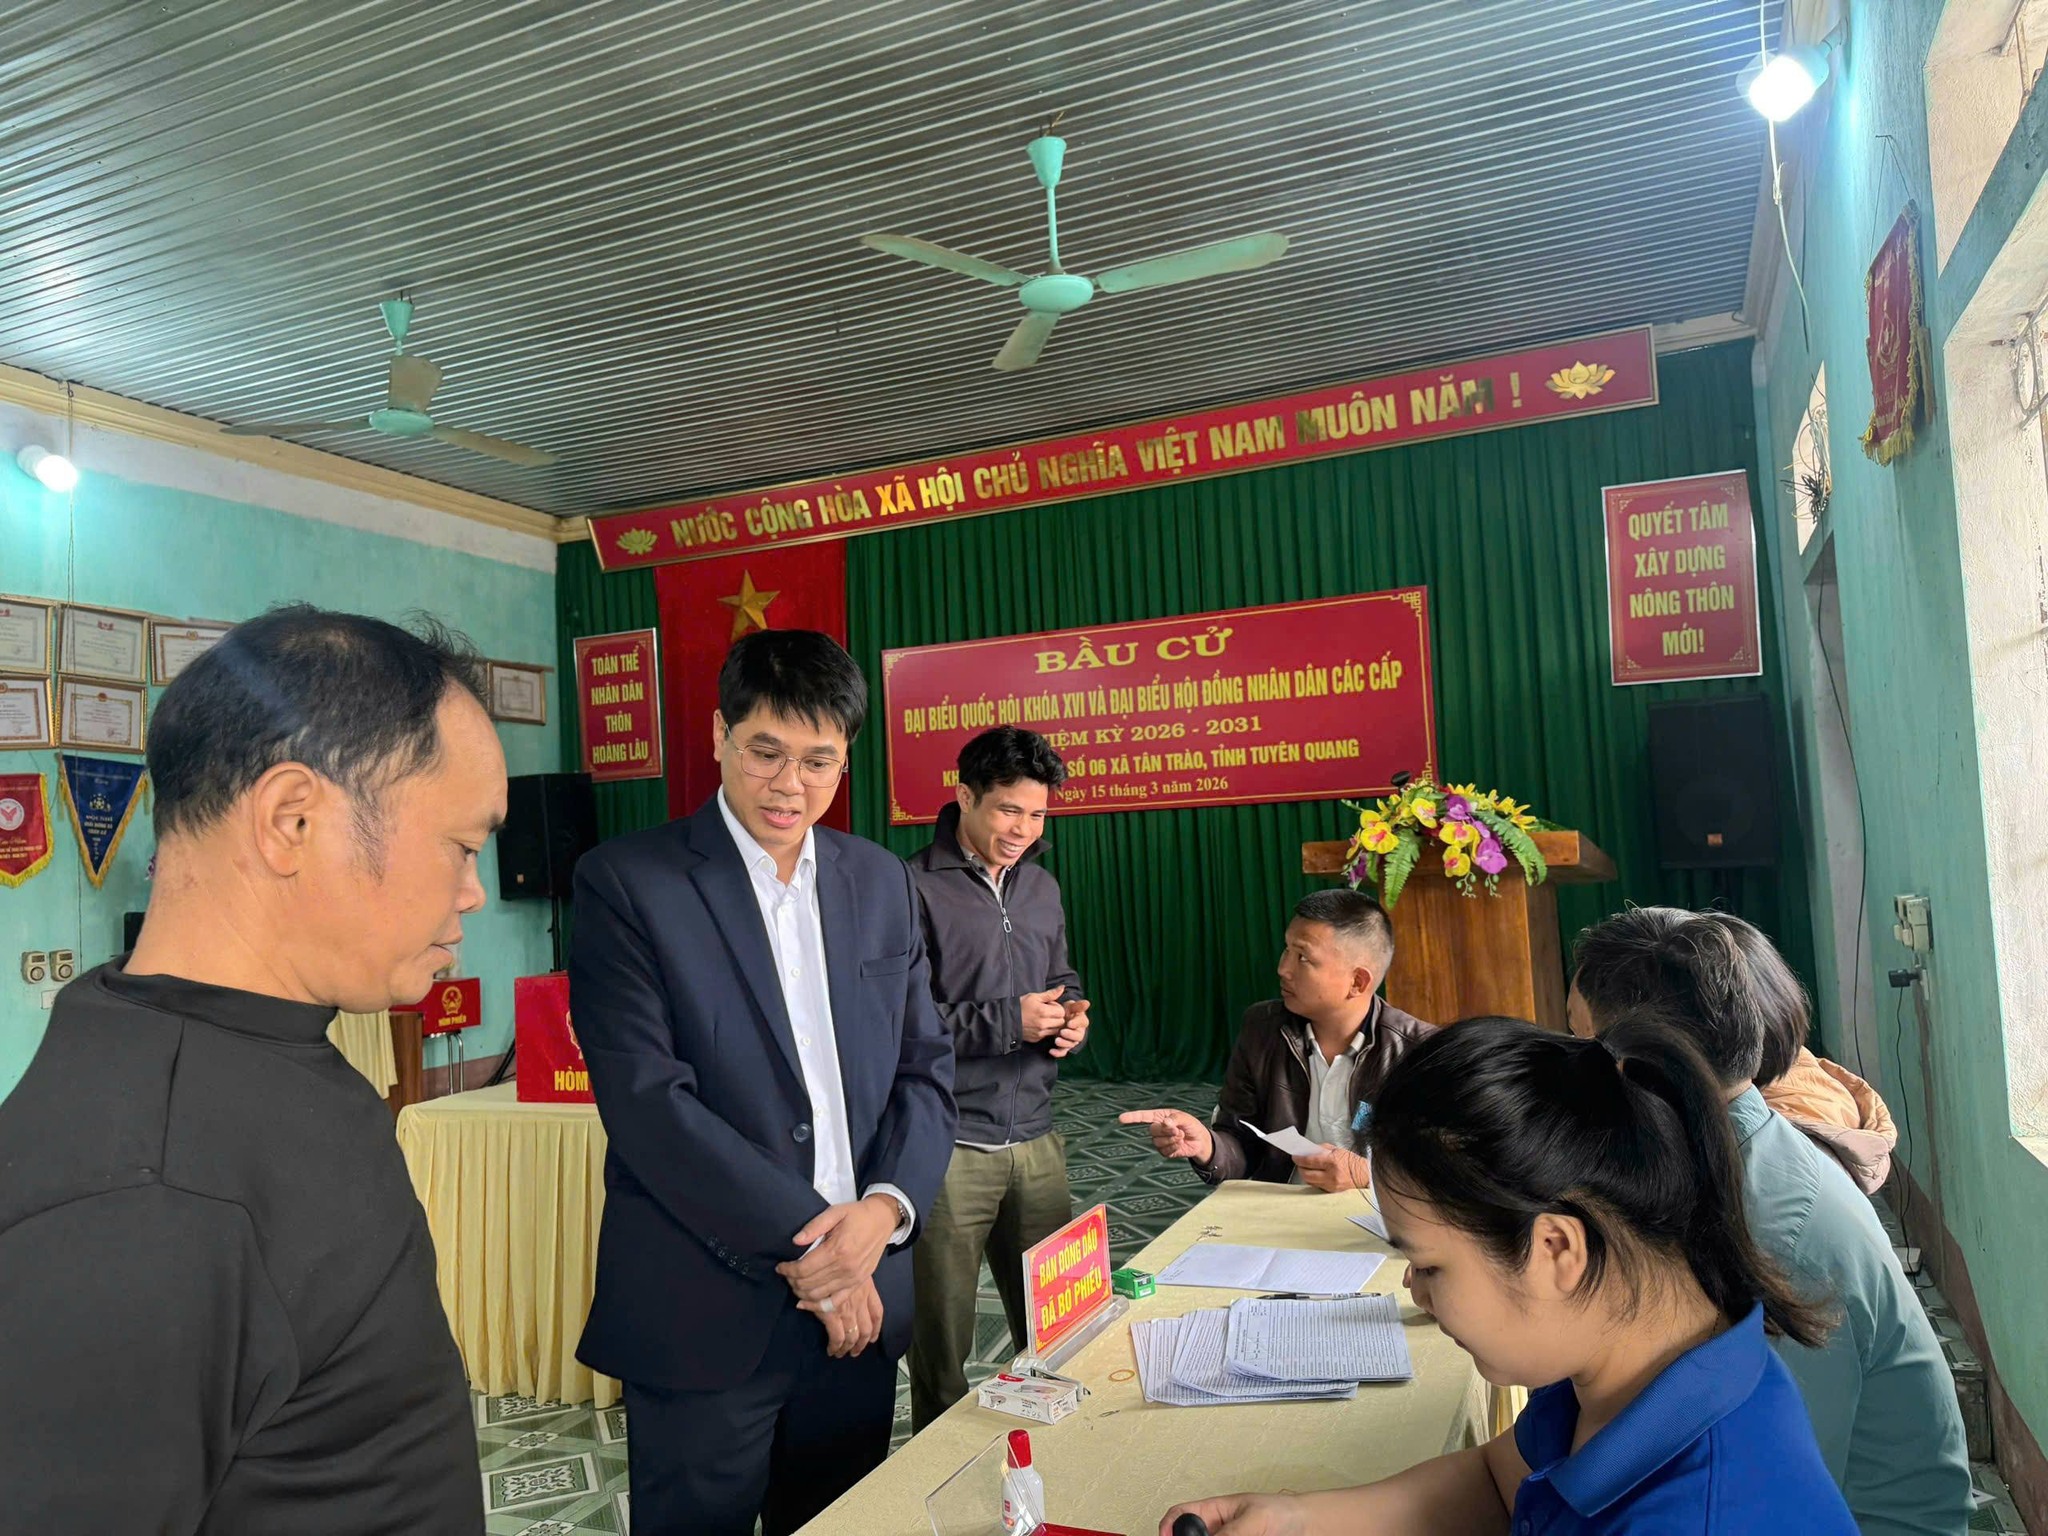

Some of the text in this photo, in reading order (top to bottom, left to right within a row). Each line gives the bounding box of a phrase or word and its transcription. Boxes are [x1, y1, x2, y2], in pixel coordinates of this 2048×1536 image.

[670, 506, 738, 548] NƯỚC
[744, 497, 814, 539] CỘNG
[817, 485, 872, 525] HÒA
[875, 475, 916, 516] XÃ
[918, 466, 966, 511] HỘI
[973, 451, 1029, 499] CHỦ
[1037, 441, 1129, 490] NGHĨA
[1136, 427, 1198, 474] VIỆT
[1208, 416, 1286, 461] NAM
[1295, 391, 1398, 444] MUÔN
[1409, 374, 1494, 426] NĂM
[1628, 500, 1729, 541] QUYẾT TÂM
[1634, 544, 1726, 578] XÂY DỰNG
[1629, 580, 1735, 619] NÔNG THÔN
[1034, 625, 1234, 674] BẦU CỬ
[1662, 622, 1705, 656] MỚI!
[591, 644, 640, 676] TOÀN THỂ
[591, 679, 644, 706] NHÂN DÂN
[904, 707, 926, 738] ĐẠI
[928, 694, 957, 731] BIỂU
[960, 692, 995, 731] QUỐC
[1023, 689, 1060, 722] KHÓA
[1062, 691, 1085, 719] XVI
[1088, 683, 1107, 716] VÀ
[1110, 687, 1134, 720] ĐẠI
[1137, 673, 1170, 712] BIỂU
[1173, 675, 1199, 714] HỘI
[1247, 666, 1291, 702] NHÂN
[1294, 662, 1328, 698] DÂN
[1331, 658, 1365, 694] CÁC
[1368, 650, 1402, 691] CẤP
[605, 710, 633, 733] THÔN
[1043, 729, 1089, 751] IỆM
[1095, 724, 1125, 744] KỲ
[1130, 722, 1186, 742] 2026
[1206, 715, 1262, 736] 2031
[592, 741, 627, 764] HOÀNG
[1067, 738, 1360, 778] SỐ 06 XÃ TÂN TRÀO, TỈNH TUYÊN QUANG
[943, 770, 959, 787] KH
[1055, 776, 1229, 803] Ngày 15 tháng 3 năm 2026
[554, 1065, 589, 1091] HÒM
[1039, 1222, 1098, 1289] BÀN ĐÓNG DẤU
[1041, 1261, 1103, 1332] ĐÃ BỎ PHIẾU
